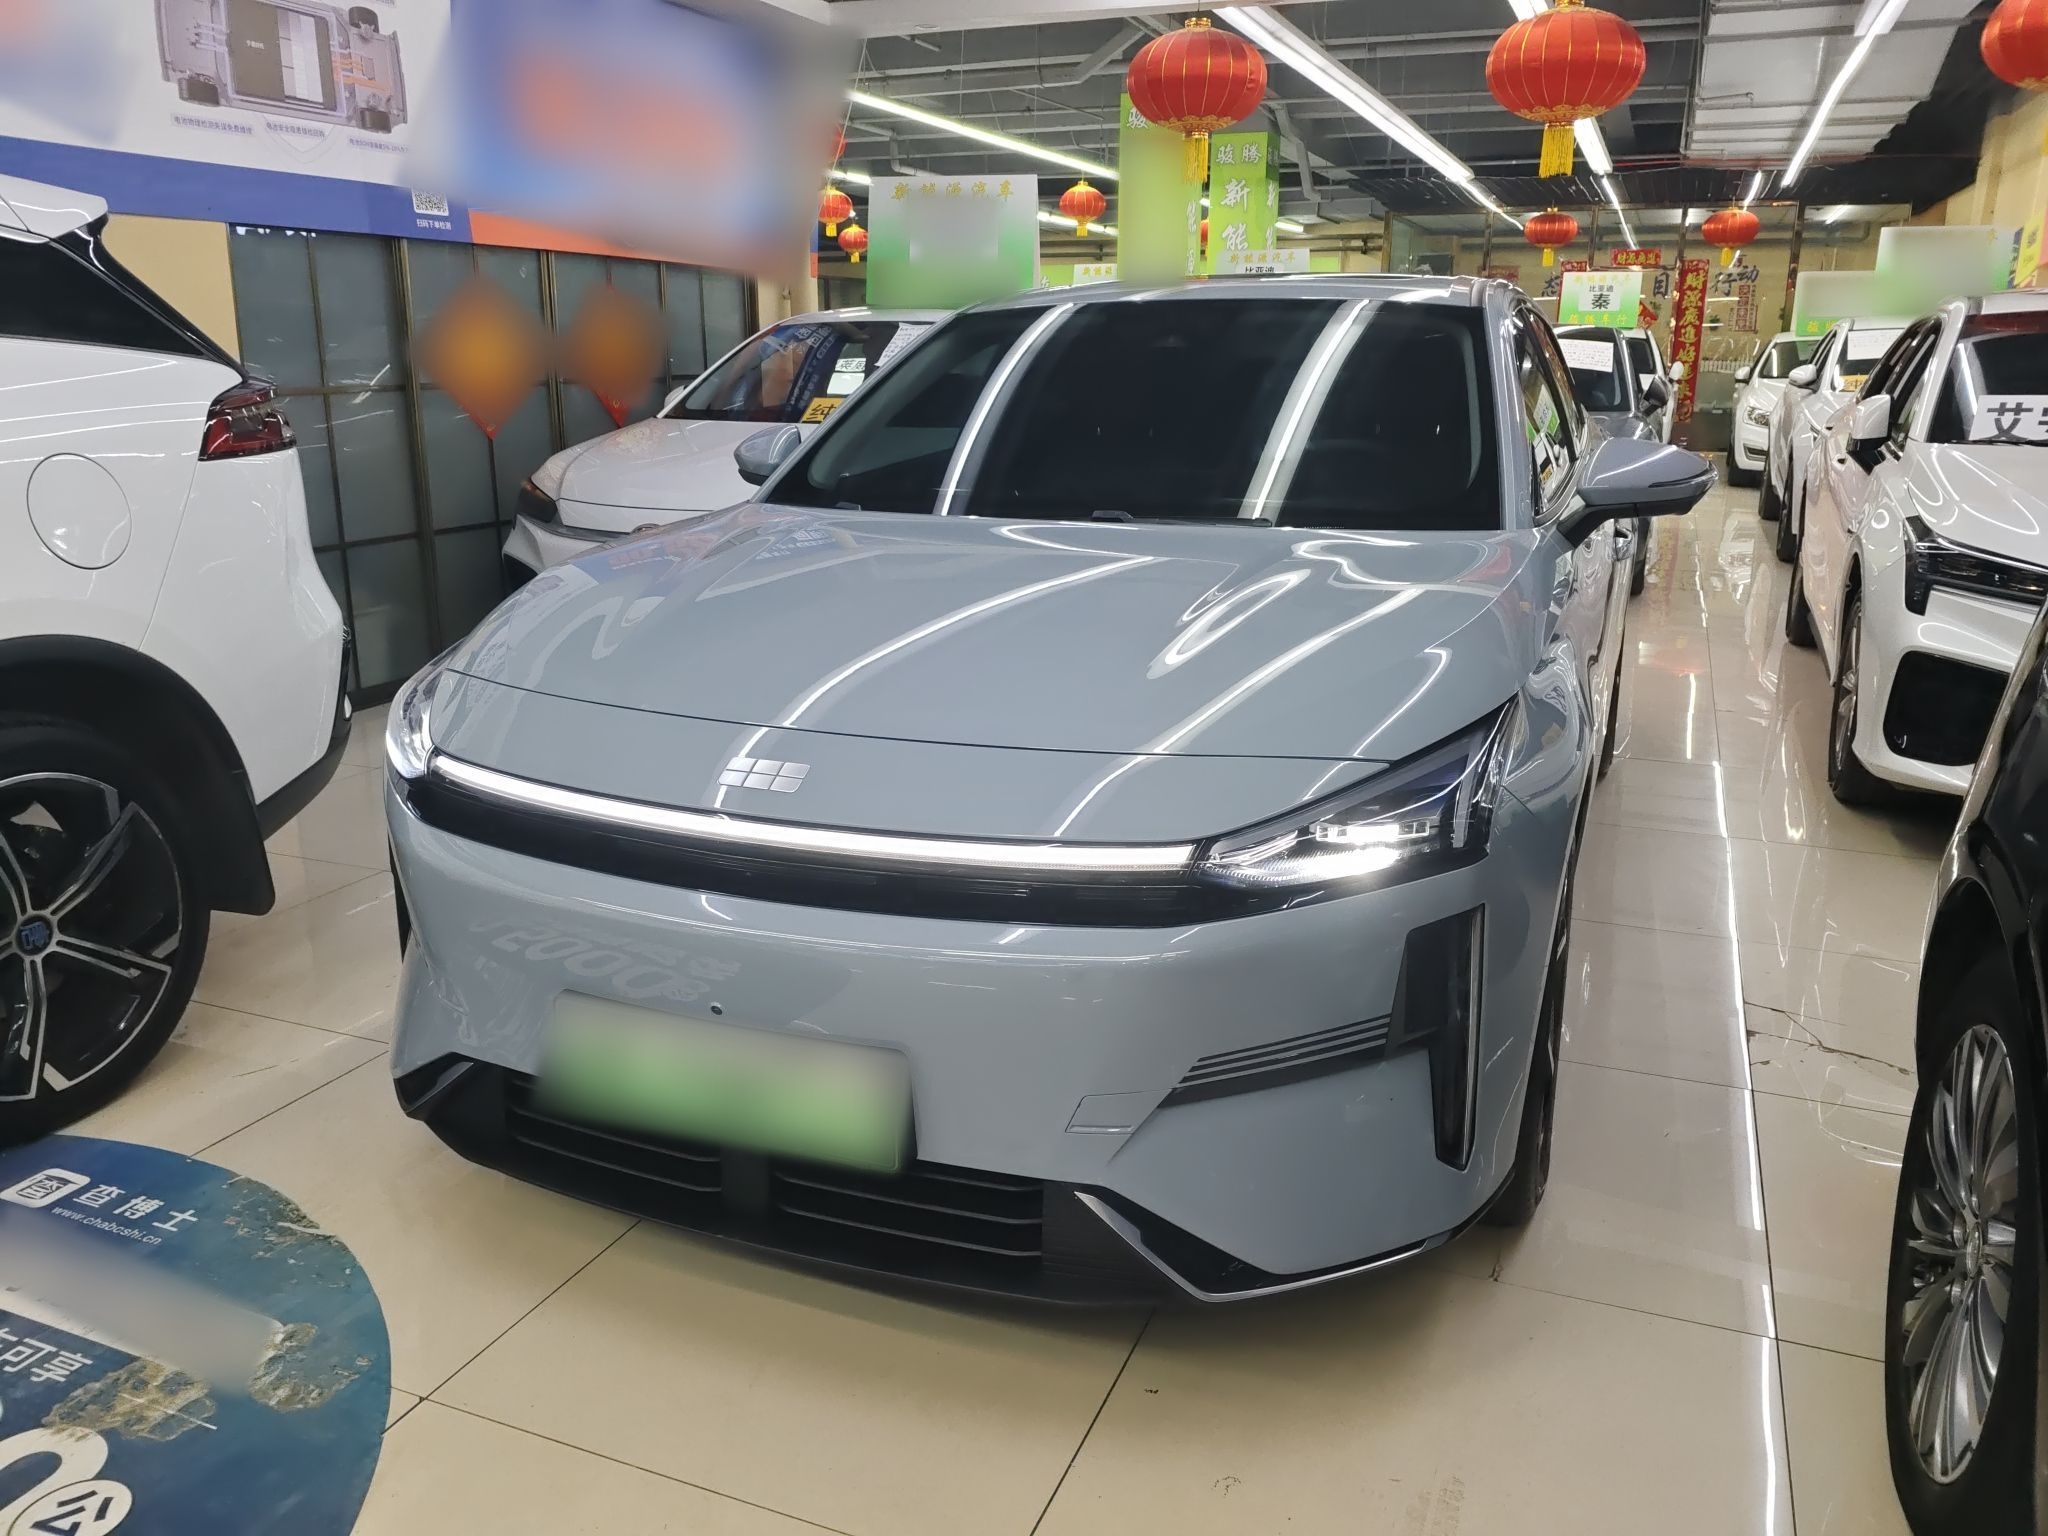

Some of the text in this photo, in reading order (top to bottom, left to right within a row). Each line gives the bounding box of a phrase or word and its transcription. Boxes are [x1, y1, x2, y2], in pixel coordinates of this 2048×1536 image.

[1216, 143, 1263, 165] 骏腾
[1588, 285, 1615, 293] 比亚迪
[1591, 293, 1612, 310] 秦
[73, 1183, 199, 1233] 查博士
